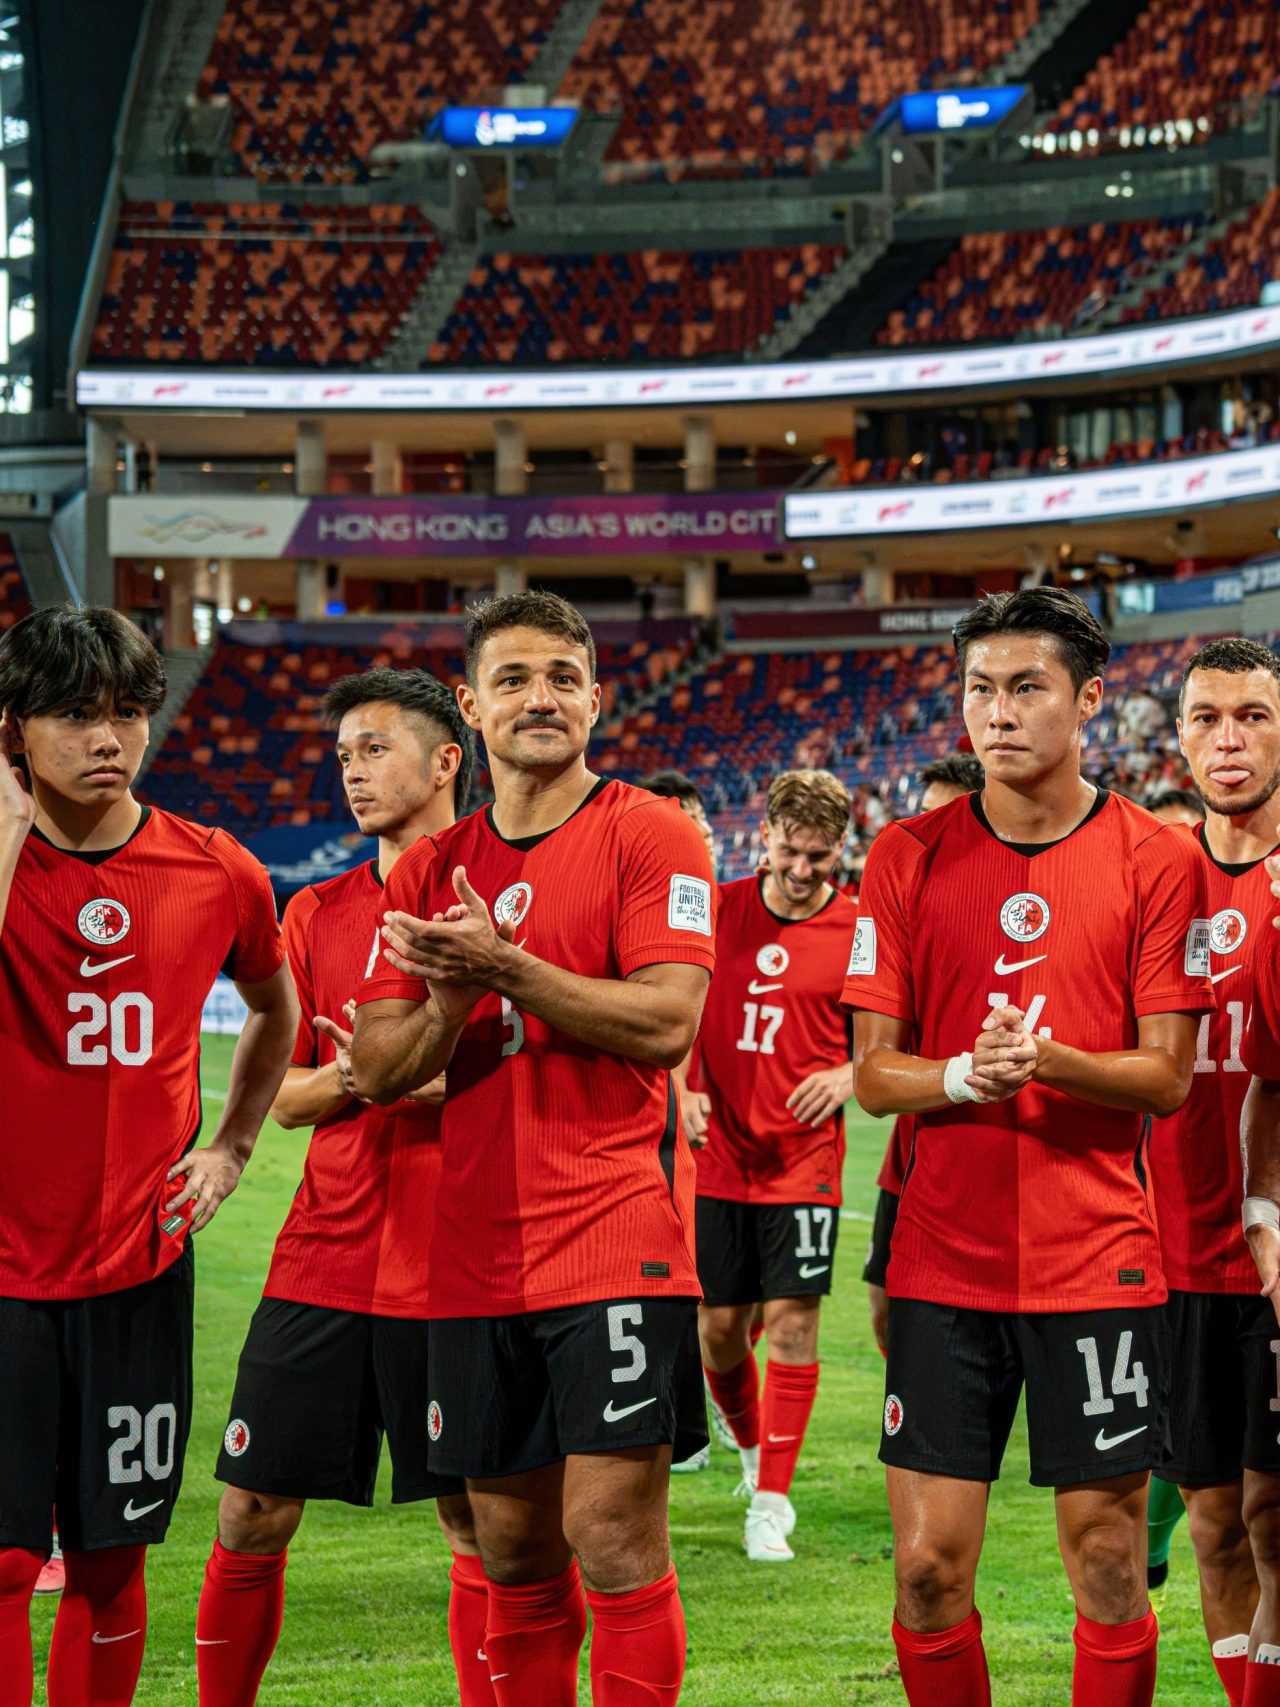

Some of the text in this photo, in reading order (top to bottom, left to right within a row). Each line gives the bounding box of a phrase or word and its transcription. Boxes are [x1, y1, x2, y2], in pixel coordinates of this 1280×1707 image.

[318, 510, 777, 542] HONG KONG ASIA'S WORLD CIT
[679, 893, 705, 909] UNITES
[680, 884, 704, 897] FOOTBALL
[67, 992, 153, 1066] 20
[736, 1002, 784, 1055] 17
[1194, 1001, 1248, 1073] 11
[794, 1207, 832, 1257] 17
[607, 1303, 647, 1383] 5
[1076, 1330, 1149, 1417] 14
[107, 1403, 177, 1484] 20
